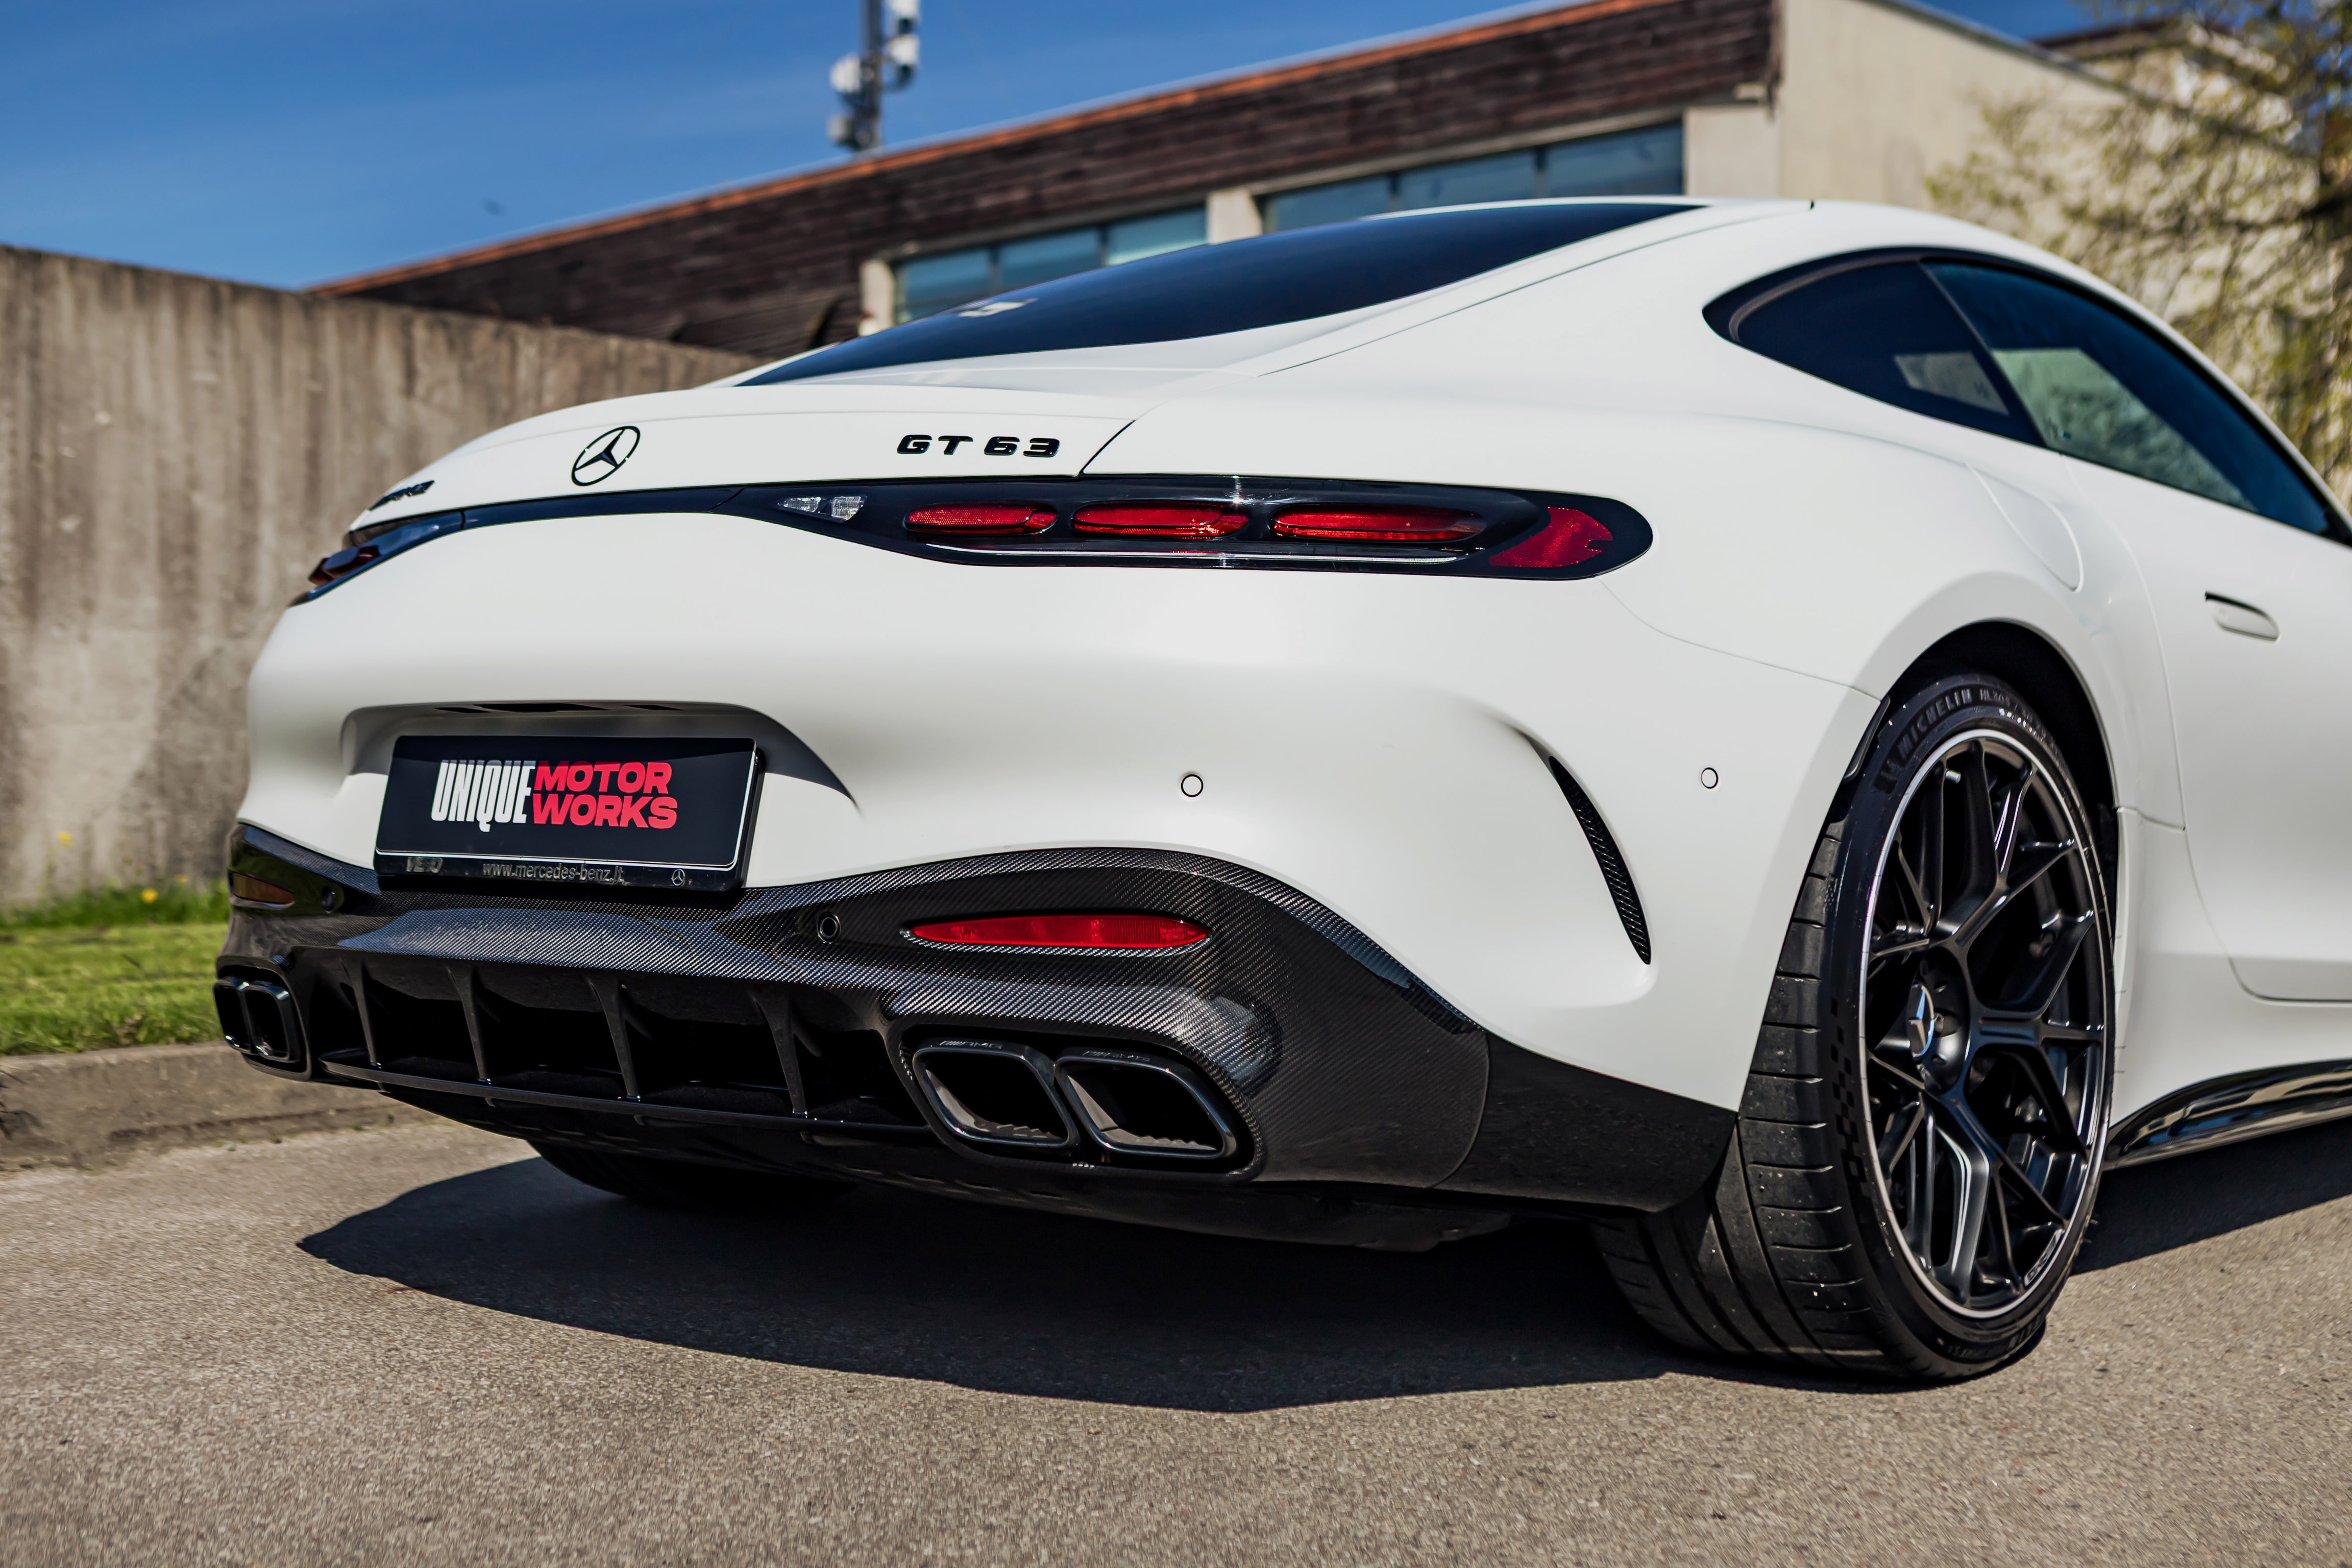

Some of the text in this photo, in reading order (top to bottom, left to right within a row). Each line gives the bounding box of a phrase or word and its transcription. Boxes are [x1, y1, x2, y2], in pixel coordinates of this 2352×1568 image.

[897, 434, 1061, 457] GT 63
[1897, 688, 1973, 760] MICHELIN
[533, 760, 672, 794] MOTOR
[431, 760, 536, 832] UNIQUE
[532, 793, 678, 829] WORKS
[483, 863, 624, 883] www.mercedes-benz.lt
